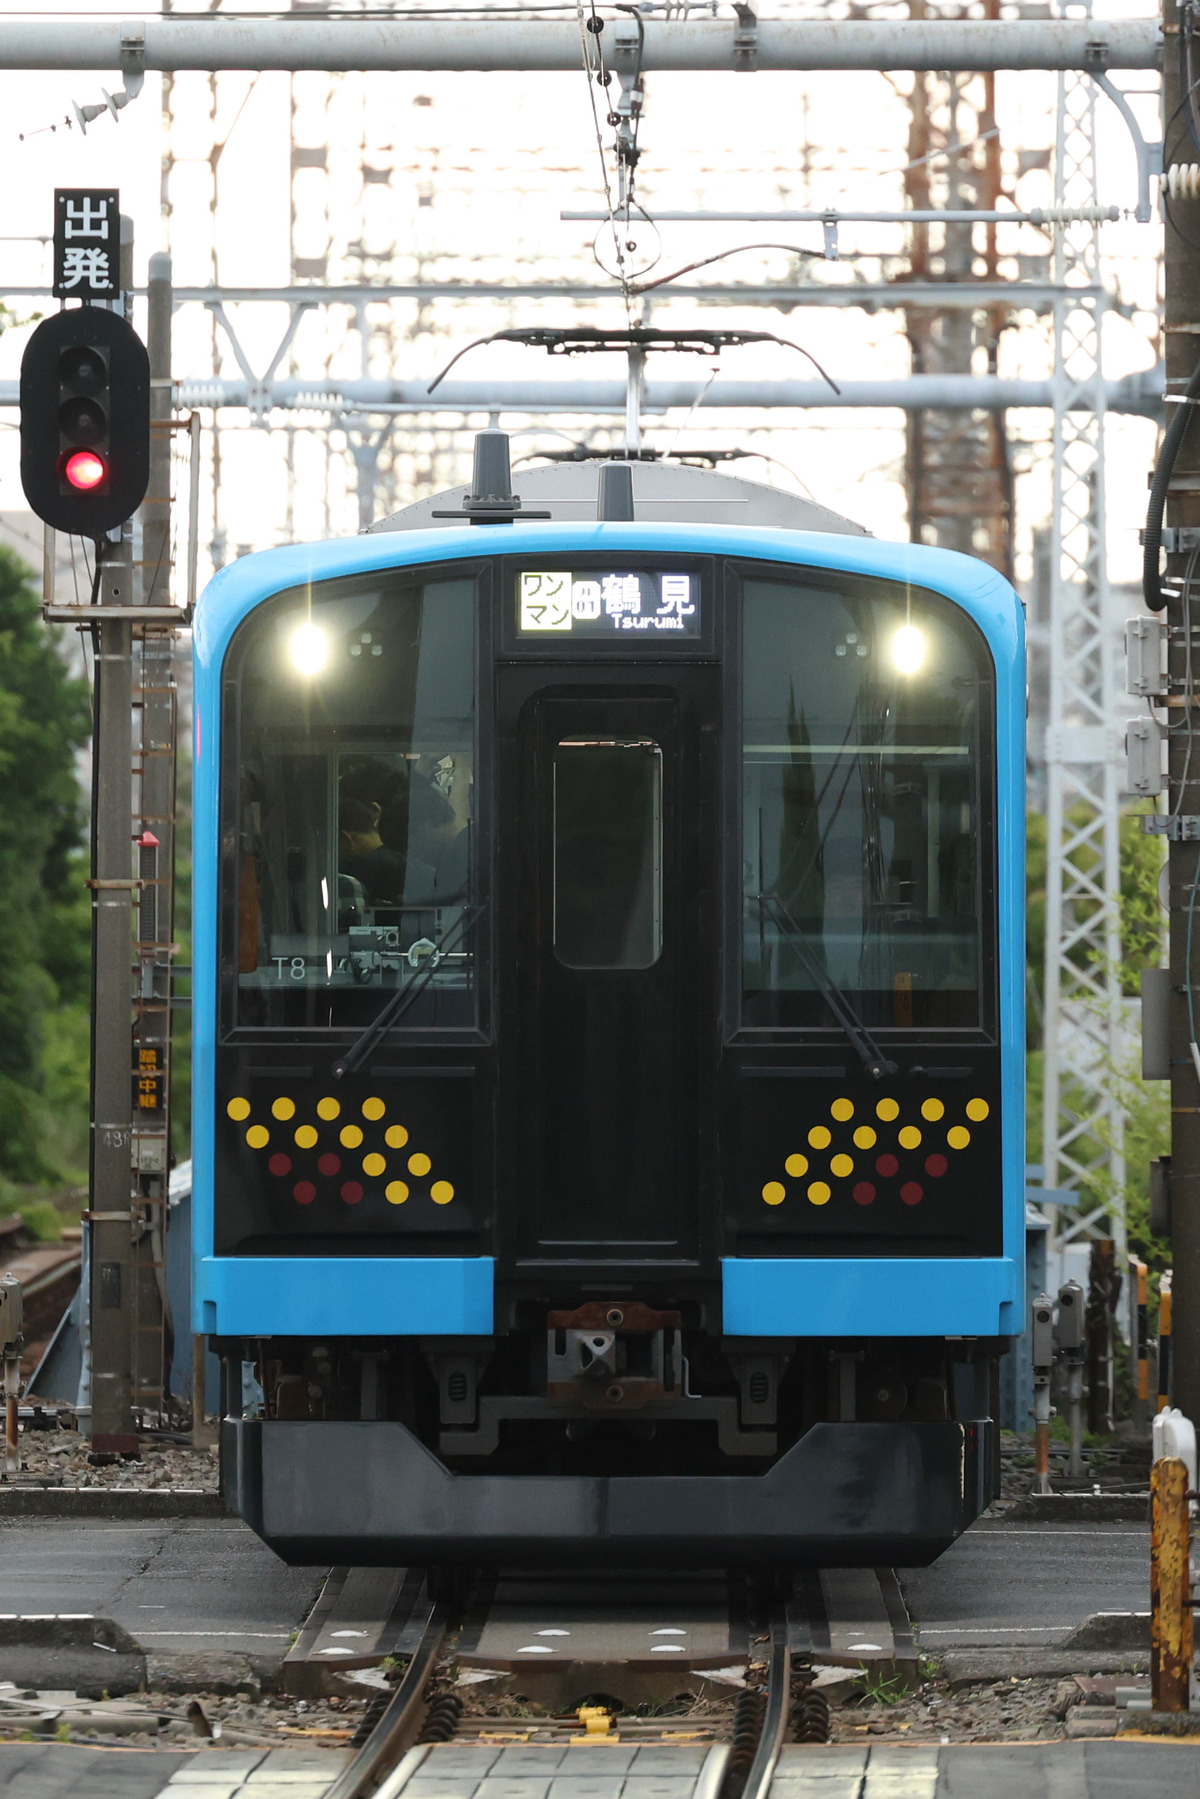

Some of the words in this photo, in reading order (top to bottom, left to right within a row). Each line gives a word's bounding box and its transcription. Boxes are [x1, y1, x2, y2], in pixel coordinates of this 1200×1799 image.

[63, 196, 110, 289] 出発
[524, 574, 564, 597] ワン
[601, 573, 696, 615] 鶴見
[526, 603, 569, 626] マン
[576, 600, 595, 613] 01
[611, 612, 685, 630] Tsurumi
[271, 956, 306, 980] T8
